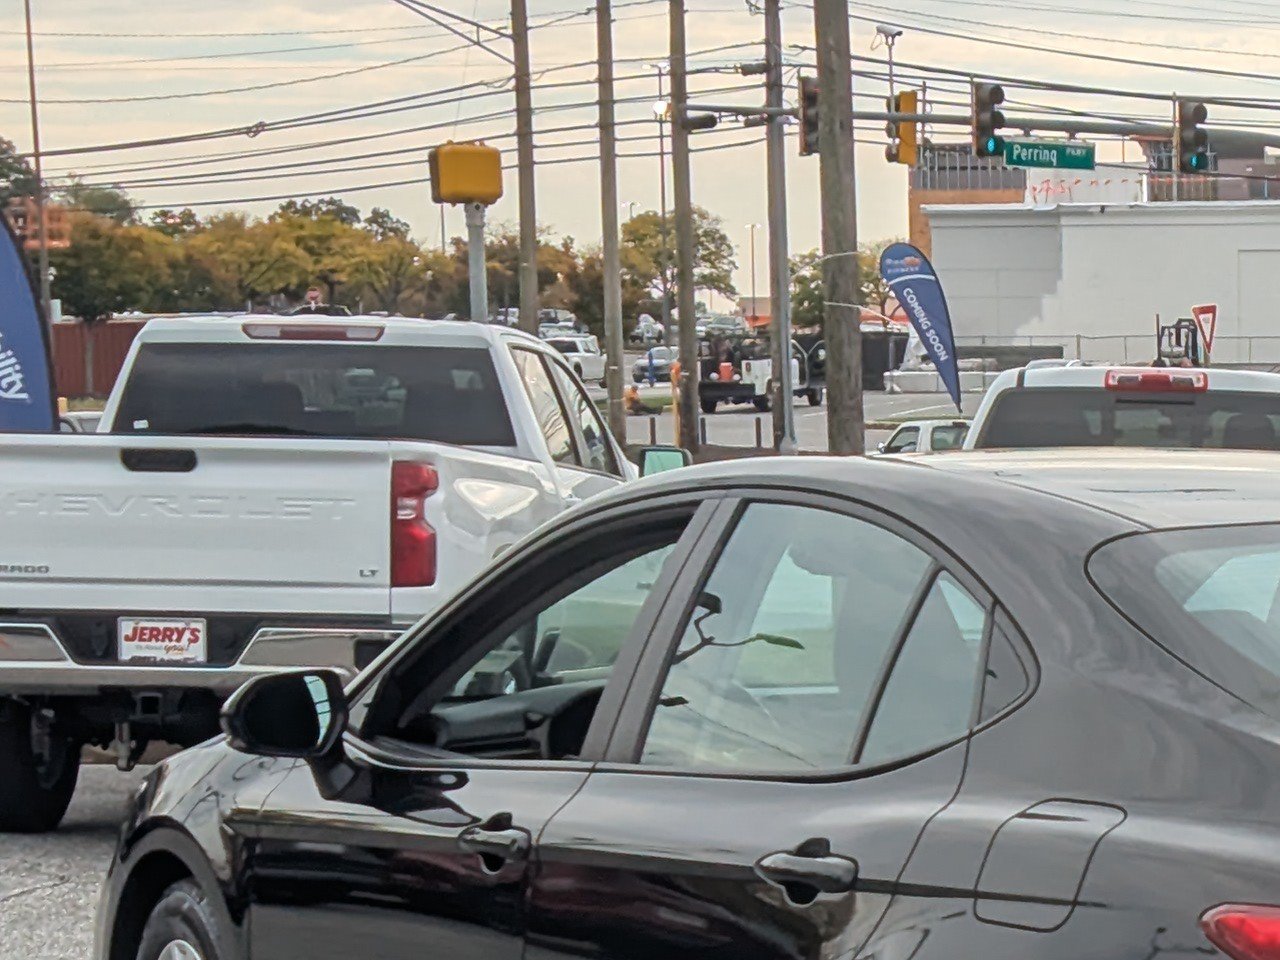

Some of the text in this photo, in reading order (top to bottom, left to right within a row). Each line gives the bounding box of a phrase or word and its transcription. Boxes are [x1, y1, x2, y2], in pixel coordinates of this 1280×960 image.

[1013, 144, 1057, 166] Perring
[902, 287, 931, 330] COMING
[925, 328, 949, 361] SOON
[4, 491, 357, 520] HEVROLET
[359, 568, 379, 578] LT
[123, 626, 201, 644] JERRY'S
